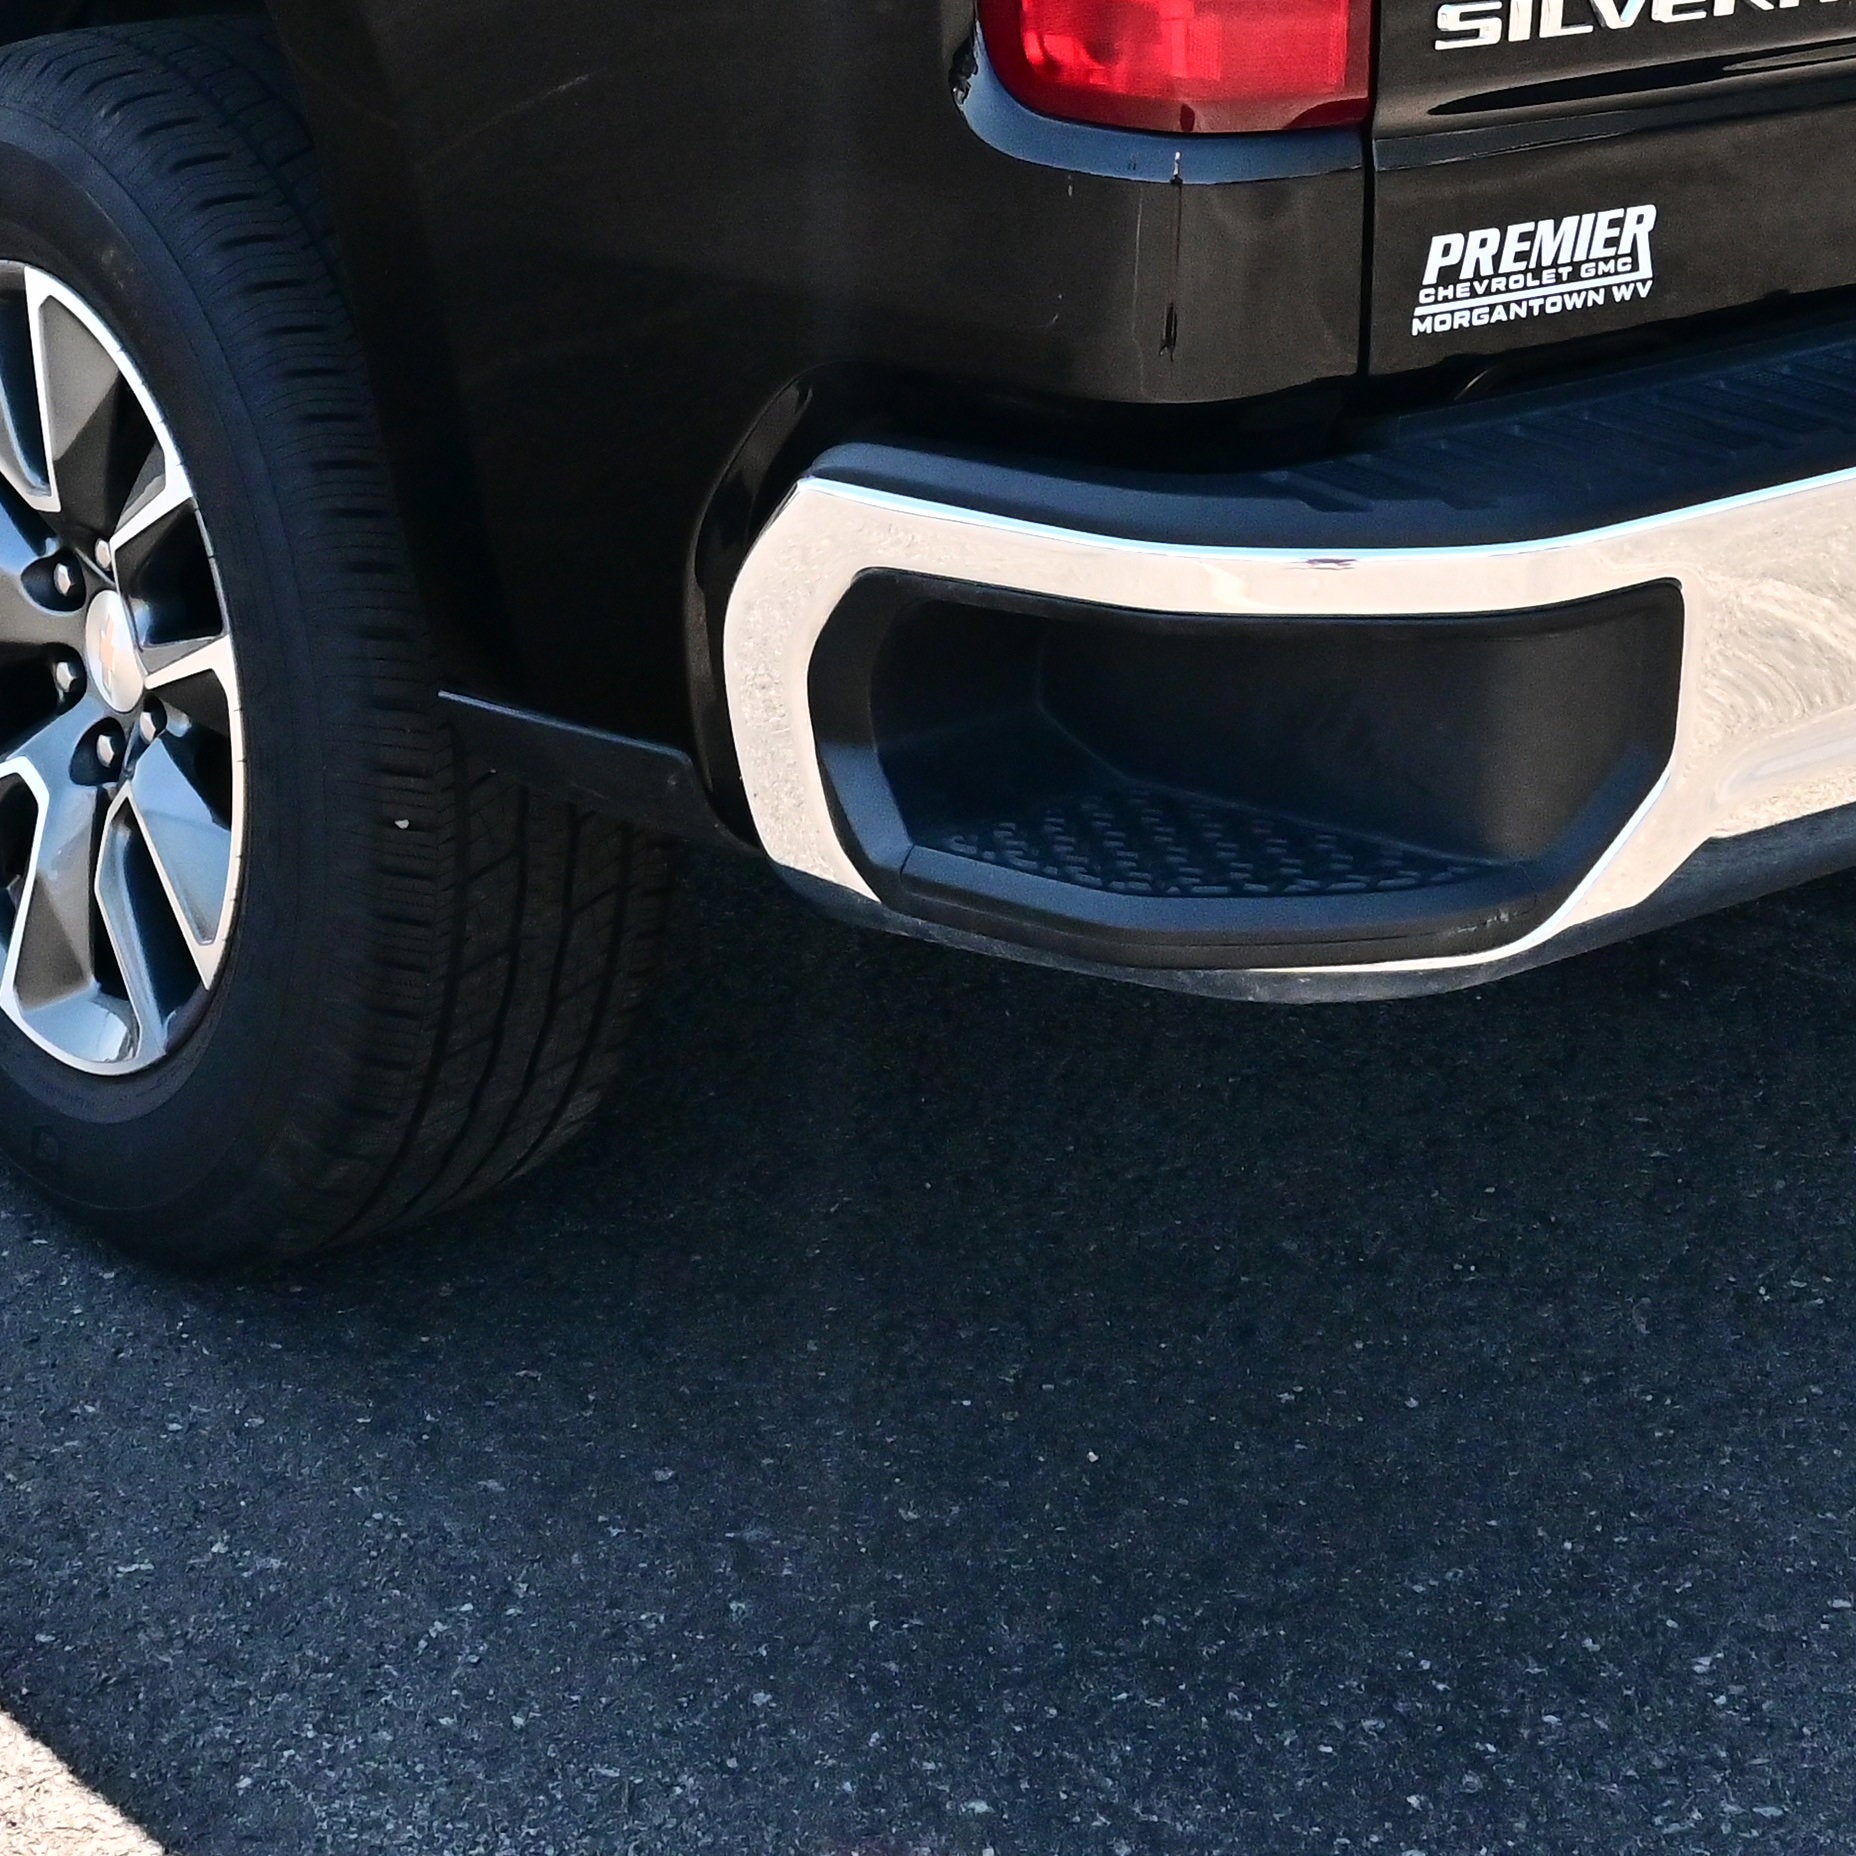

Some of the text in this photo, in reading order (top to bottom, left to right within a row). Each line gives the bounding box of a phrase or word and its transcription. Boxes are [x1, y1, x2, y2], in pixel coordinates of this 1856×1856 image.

[1422, 204, 1657, 286] PREMIER
[1411, 279, 1653, 336] MORGANTOWN WV
[1418, 256, 1633, 304] CHEVROLET GMC
